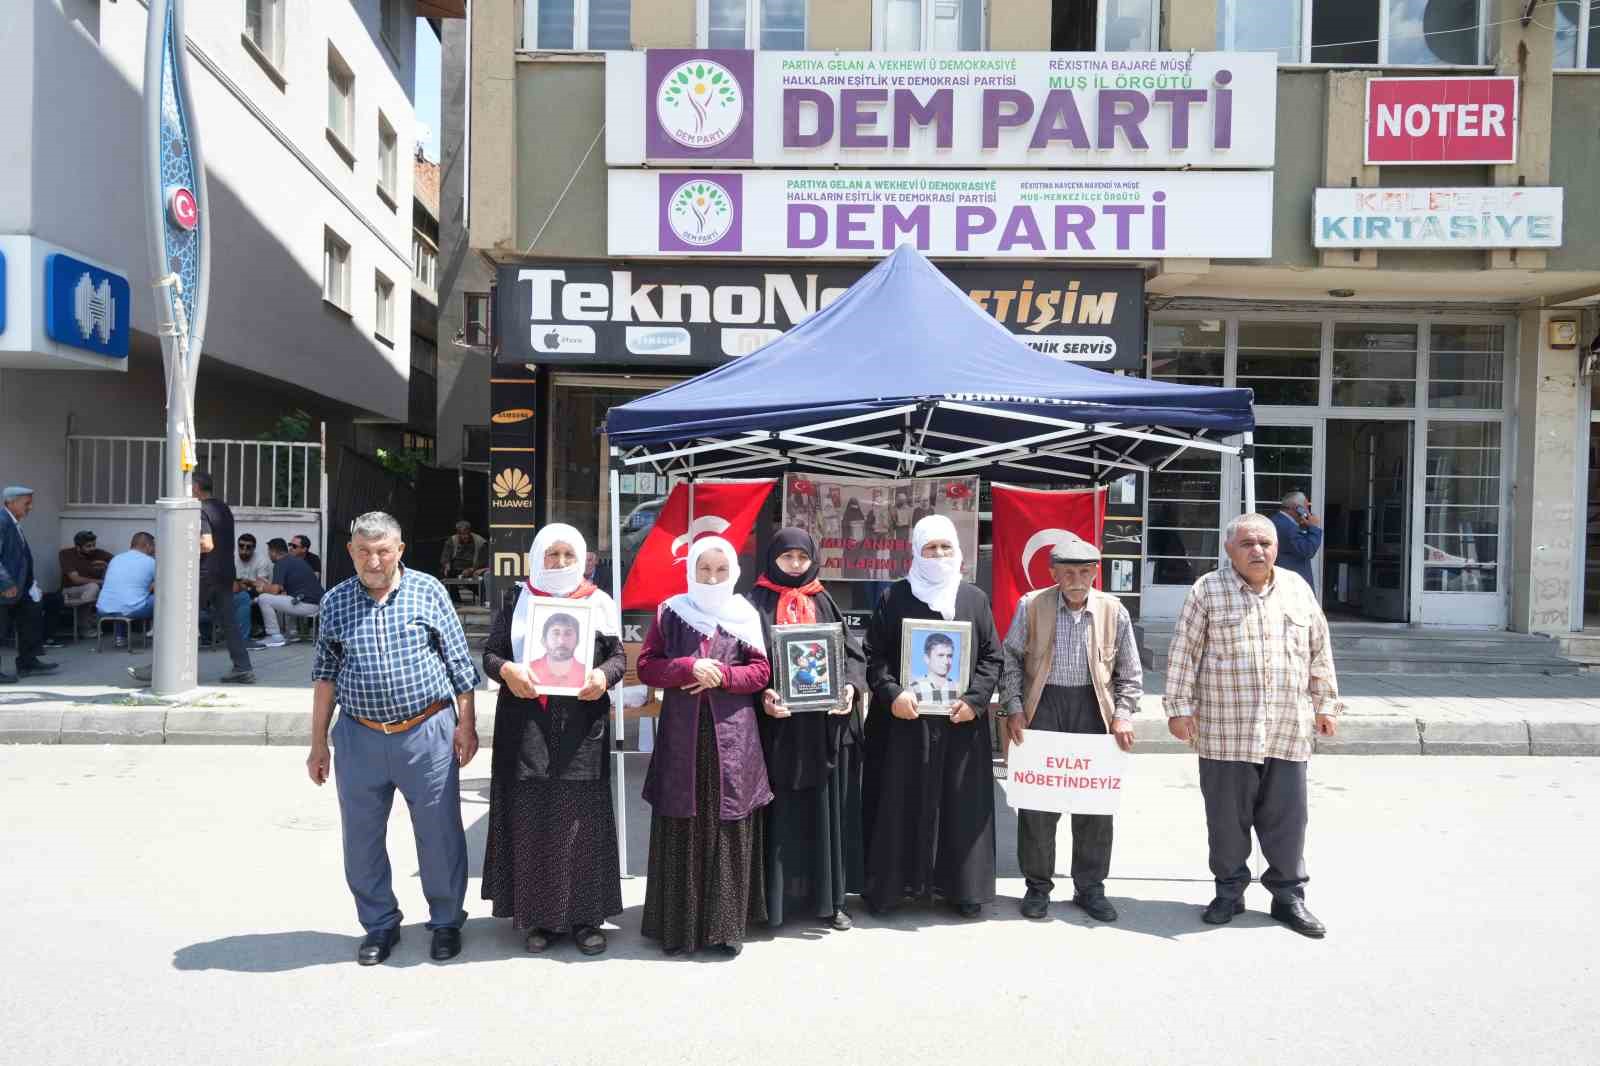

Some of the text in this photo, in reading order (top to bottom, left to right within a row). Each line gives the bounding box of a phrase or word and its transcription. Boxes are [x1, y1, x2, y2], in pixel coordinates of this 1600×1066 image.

[782, 59, 824, 71] PARTIYA
[828, 60, 864, 71] GELAN
[866, 60, 876, 70] A
[782, 74, 1017, 88] HALKLARIN EŞİTLİK VE DEMOKRASİ PARTİSİ
[1048, 73, 1193, 91] MUŞ İL ÖRGÜTÜ
[782, 69, 1234, 149] DEM PARTİ
[1376, 103, 1507, 137] NOTER
[675, 127, 695, 143] DEM
[830, 180, 863, 190] GELAN
[865, 180, 872, 189] A
[786, 190, 997, 203] HALKLARIN EŞİTLİK VE DEMOKRASİ PARTİSİ
[786, 190, 1167, 251] DEM PARTİ
[1321, 211, 1556, 241] KIRTASİYE
[1063, 340, 1113, 355] SERVİS
[492, 499, 533, 509] HUAWEI
[1045, 756, 1092, 771] EVLAT
[1013, 770, 1121, 790] NÖBETİNDEYİZ
